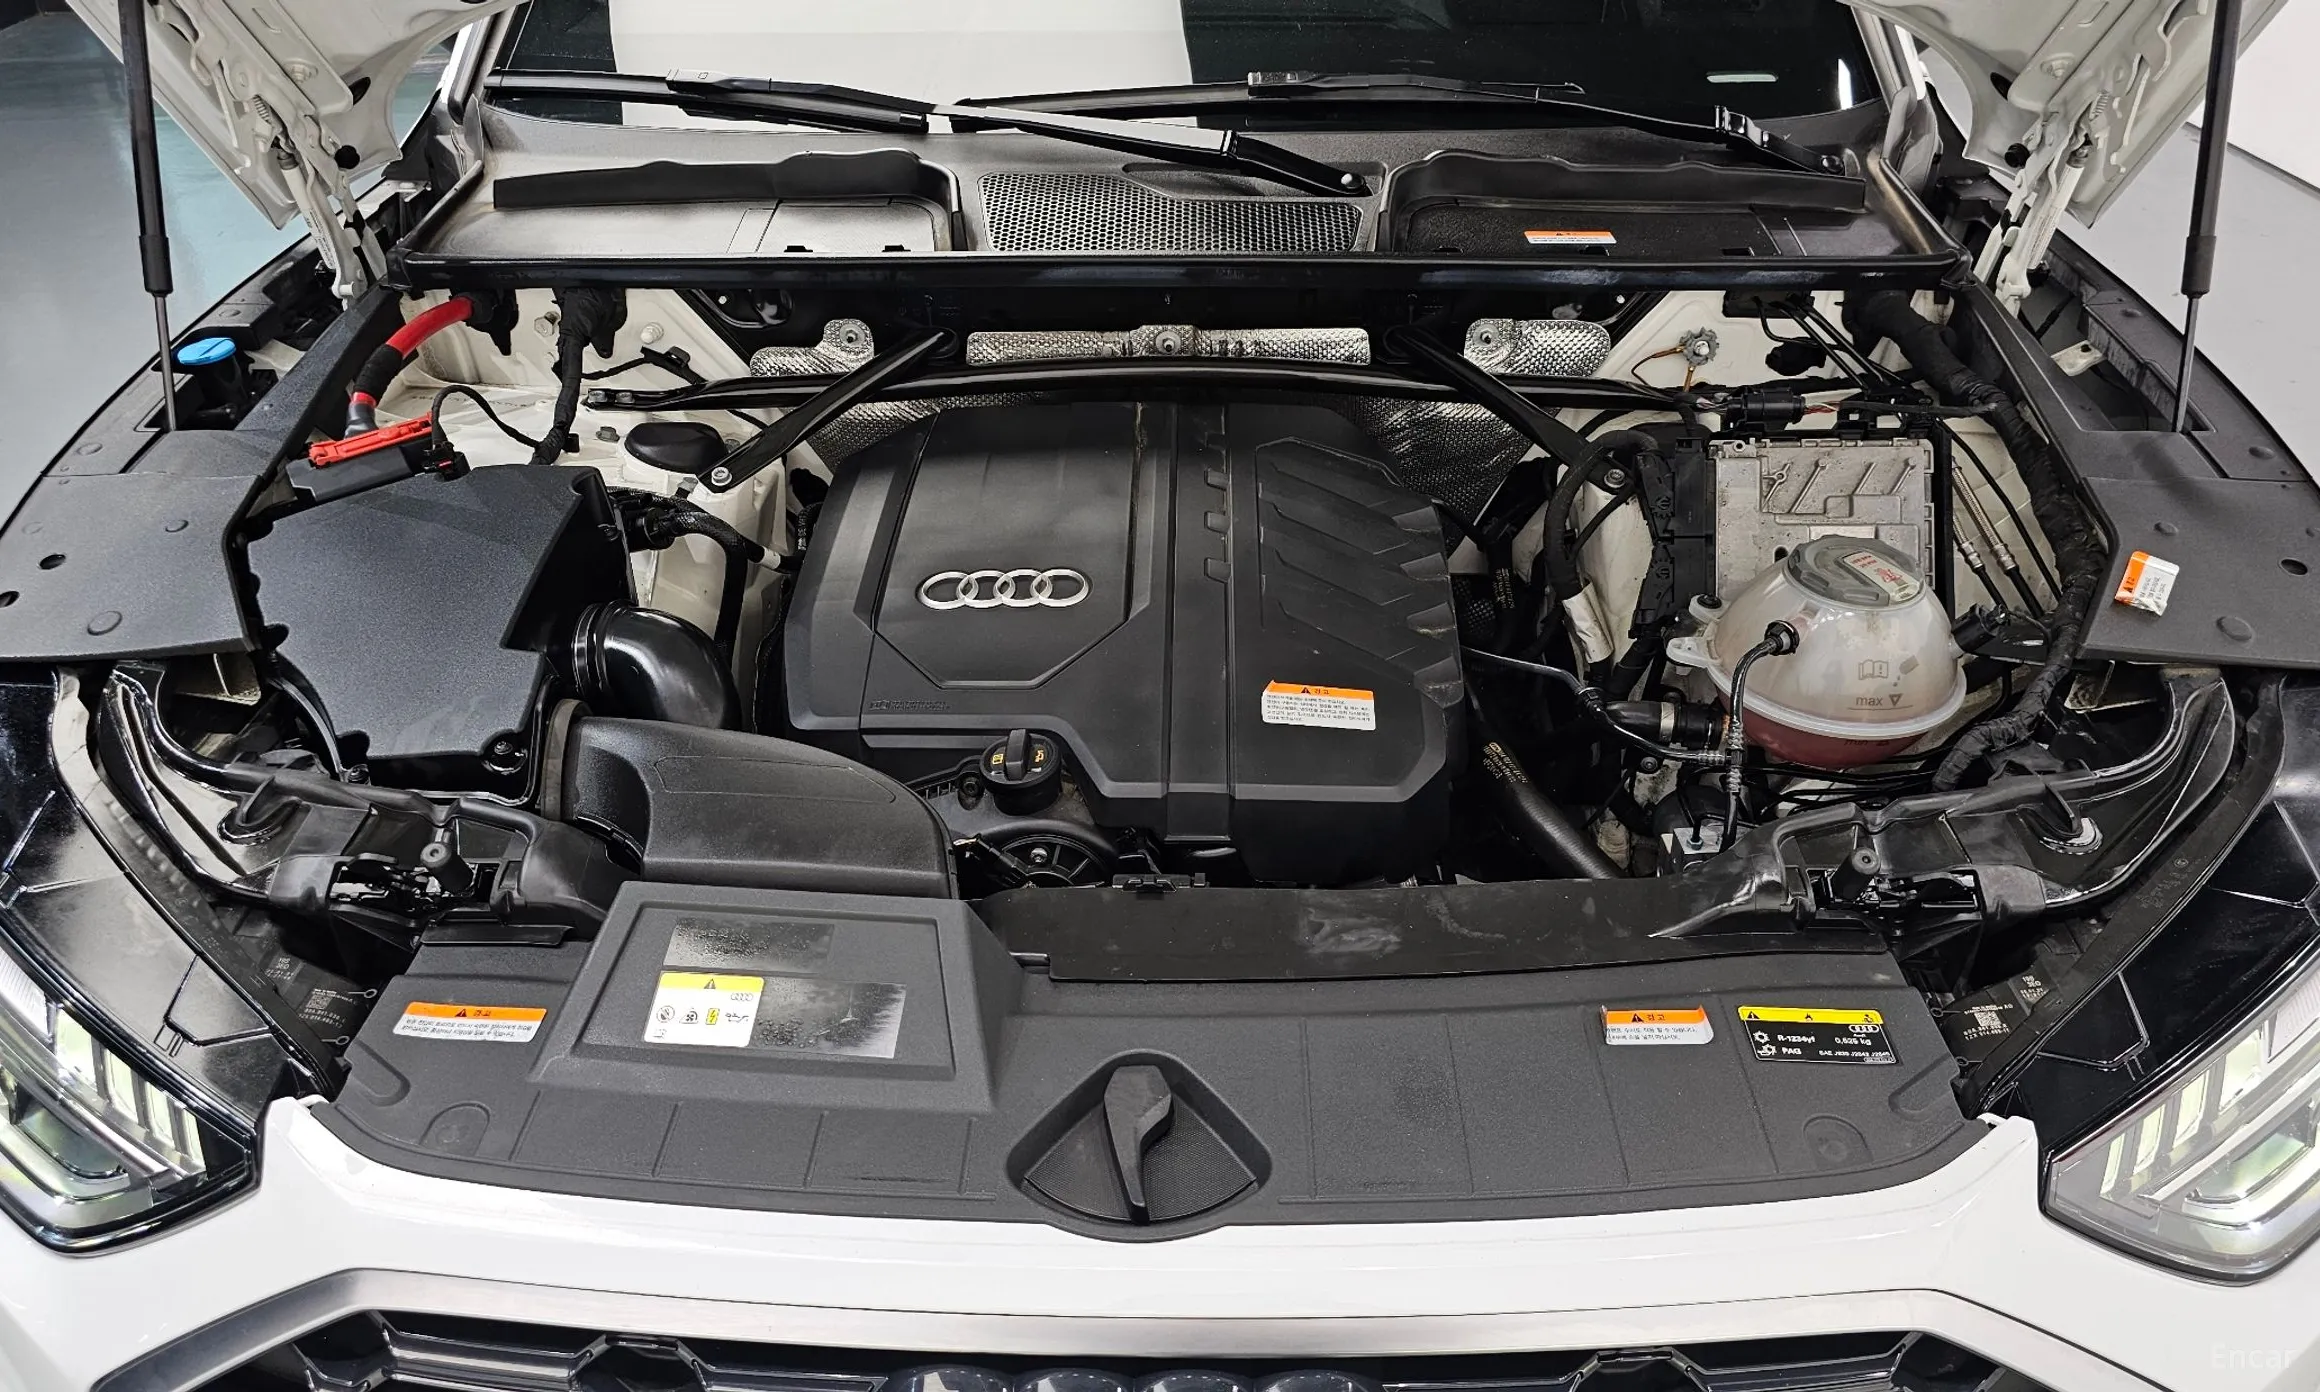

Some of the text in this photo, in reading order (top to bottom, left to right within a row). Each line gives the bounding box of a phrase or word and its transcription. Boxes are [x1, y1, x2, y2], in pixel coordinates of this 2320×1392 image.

[1855, 696, 1884, 706] max
[1777, 1034, 1816, 1044] R-1234yf
[1860, 1038, 1872, 1046] kg
[1781, 1047, 1802, 1055] PAG
